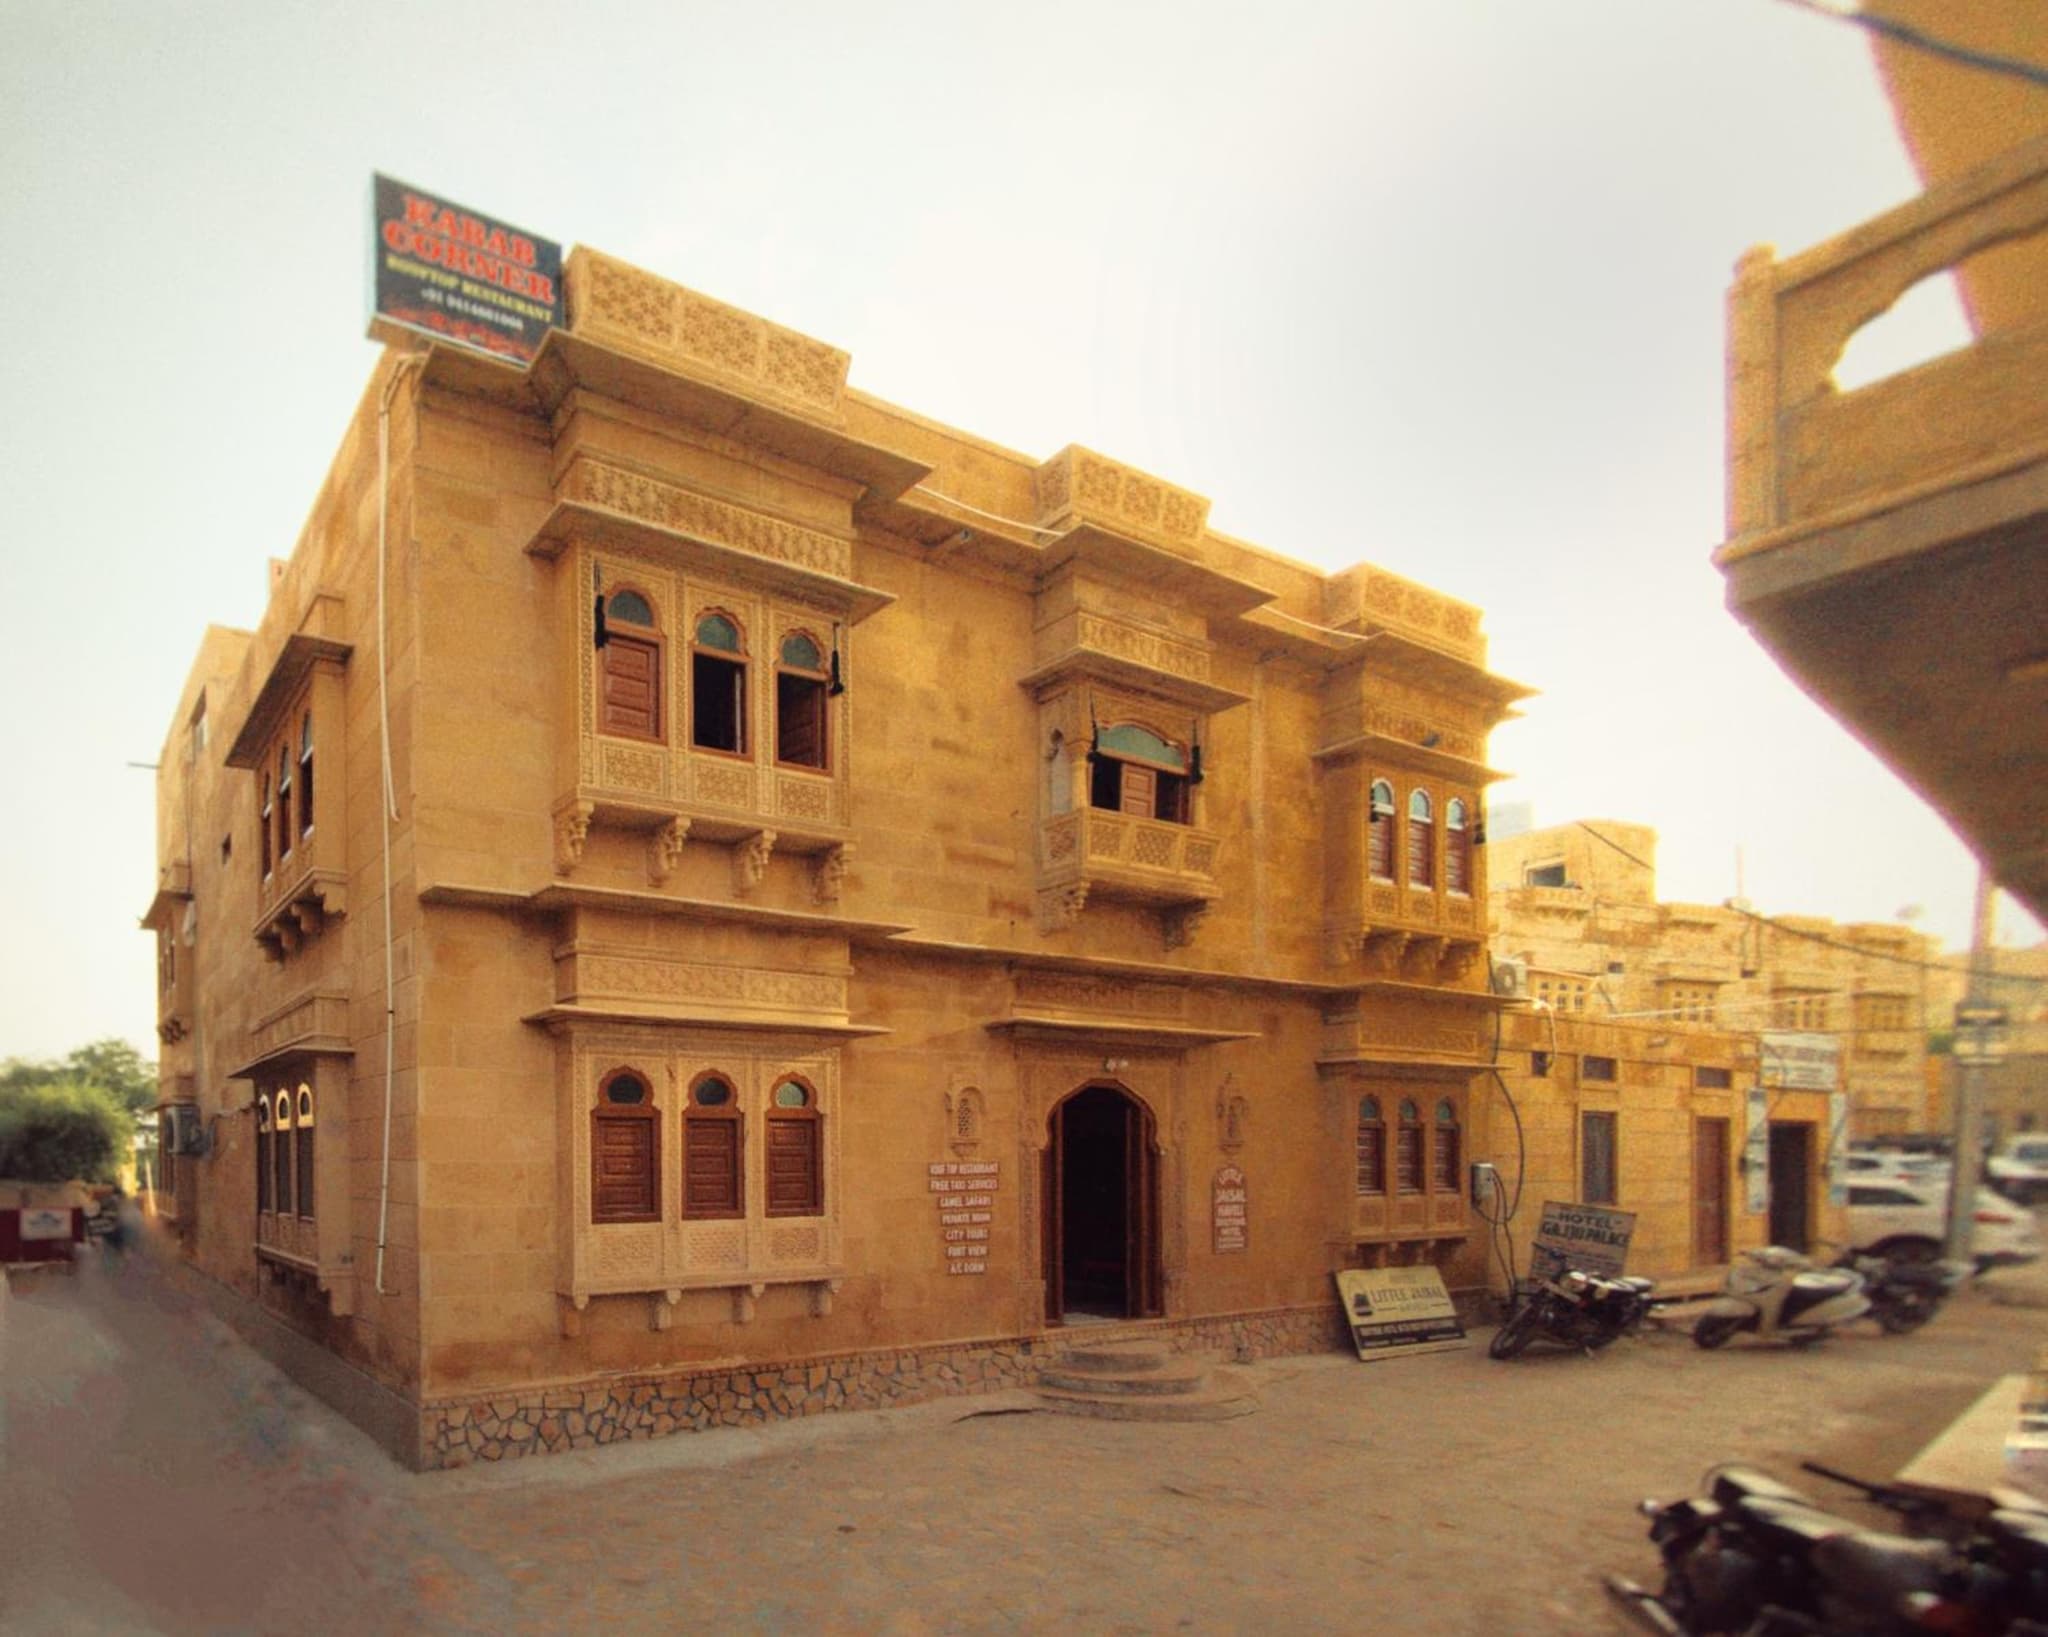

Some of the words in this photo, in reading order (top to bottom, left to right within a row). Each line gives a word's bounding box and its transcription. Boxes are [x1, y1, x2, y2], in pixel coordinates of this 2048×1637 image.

[404, 193, 536, 268] KABAB
[383, 219, 556, 305] CORNER
[461, 279, 552, 323] RESTAURANT
[959, 1162, 999, 1174] RESTAURANT
[930, 1179, 950, 1191] FREE
[967, 1178, 998, 1190] SERVICES
[940, 1196, 963, 1208] CAMEL
[965, 1195, 992, 1207] SAFARI
[942, 1213, 970, 1225] PRIVATE
[1559, 1212, 1615, 1230] HOTEL
[946, 1230, 964, 1241] CITY
[947, 1246, 967, 1257] FORT
[968, 1245, 988, 1257] VIEW
[1370, 1287, 1409, 1303] LITTLE
